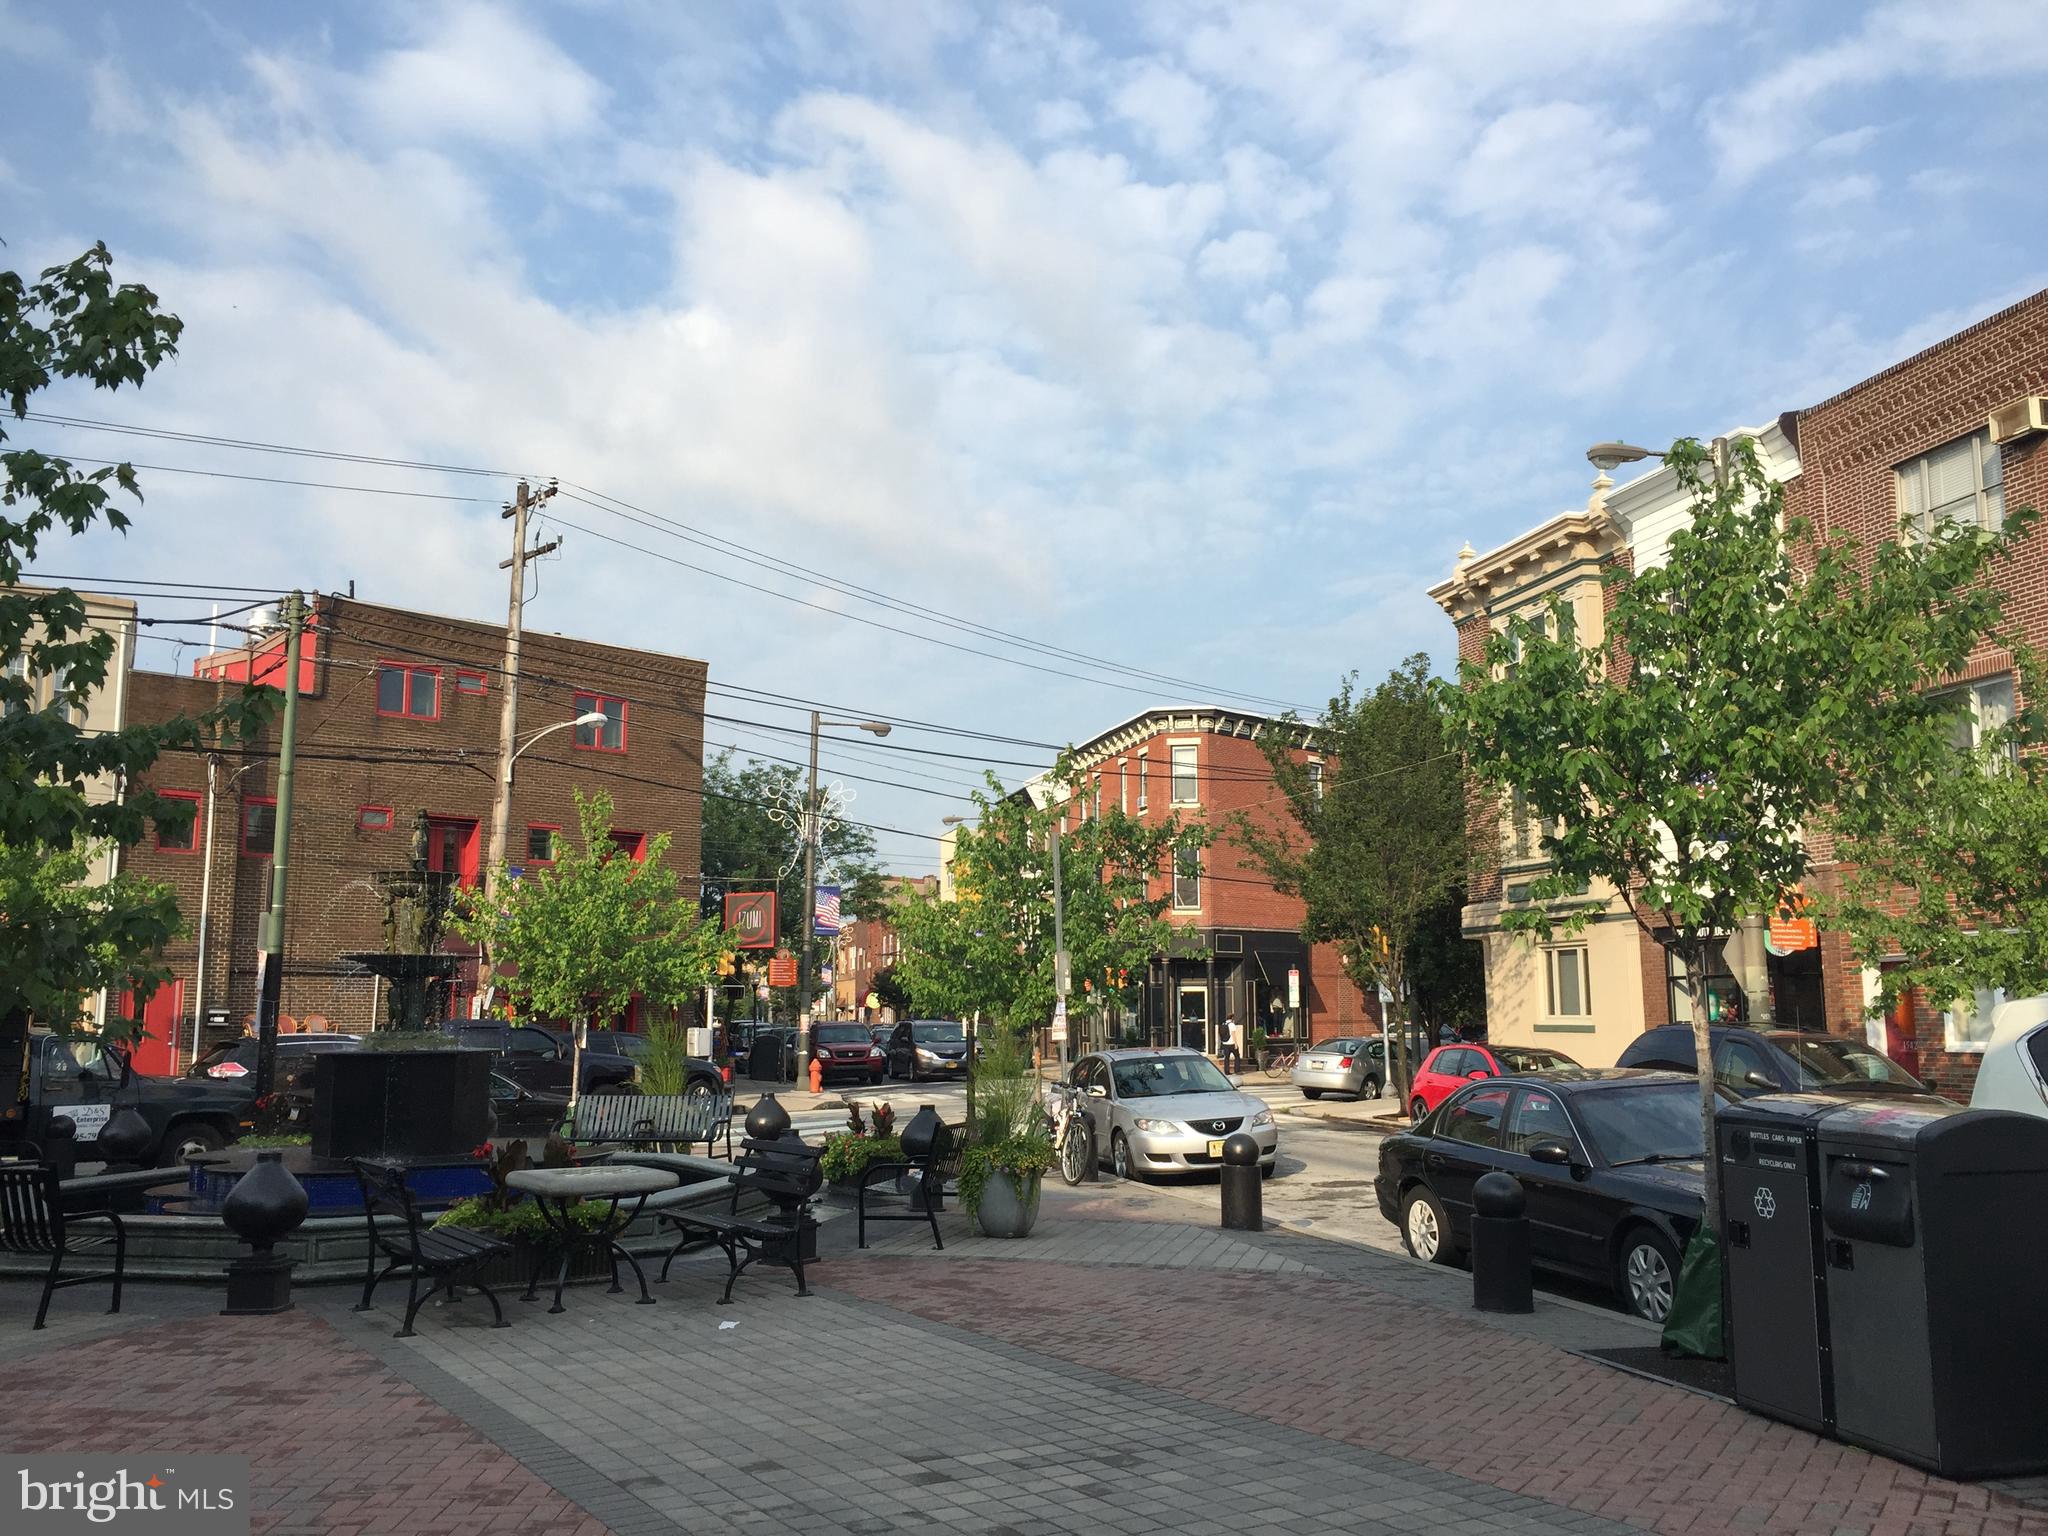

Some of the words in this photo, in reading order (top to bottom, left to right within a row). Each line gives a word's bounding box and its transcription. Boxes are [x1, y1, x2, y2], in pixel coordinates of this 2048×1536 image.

[738, 910, 762, 930] IZUMI
[1749, 1131, 1770, 1140] BOTTLES
[1771, 1134, 1785, 1142] CANS
[1786, 1136, 1802, 1144] PAPER
[1758, 1158, 1783, 1168] RECYCLING
[1783, 1161, 1796, 1170] ONLY
